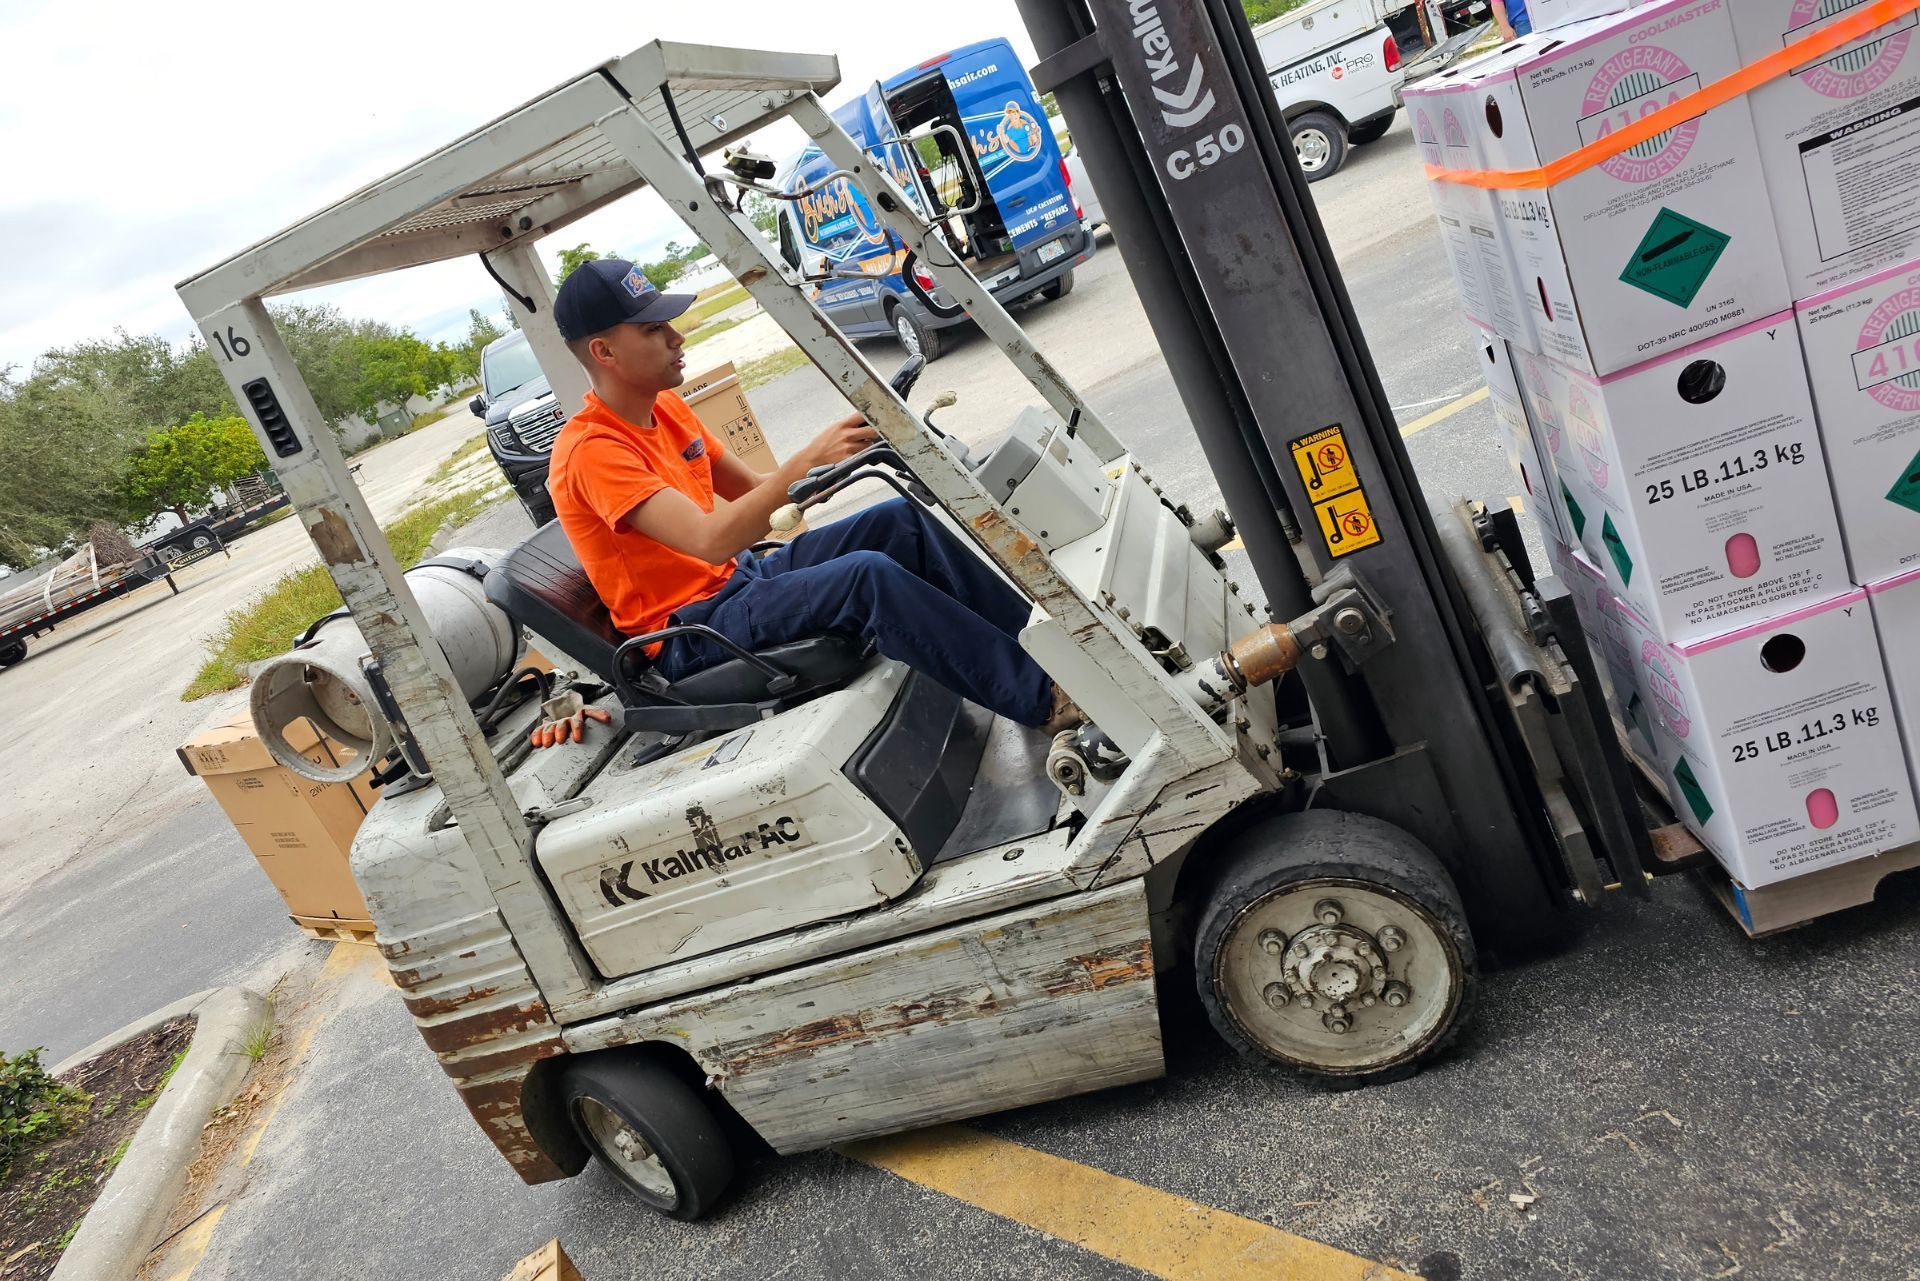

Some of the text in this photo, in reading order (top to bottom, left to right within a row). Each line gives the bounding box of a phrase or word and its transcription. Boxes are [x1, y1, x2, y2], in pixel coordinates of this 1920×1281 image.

[1628, 0, 1722, 45] COOLMASTER
[1280, 59, 1326, 87] HEATING,
[1326, 51, 1347, 68] INC.
[1346, 53, 1373, 71] PRO
[1530, 70, 1543, 81] Net
[1583, 58, 1595, 70] kg)
[1588, 48, 1682, 104] REFRIGERANT
[1808, 37, 1907, 97] REFRIGERANT
[1829, 107, 1902, 140] WARNING
[1602, 126, 1696, 181] REFRIGERANT
[1647, 185, 1662, 196] AND
[1650, 192, 1665, 204] AND
[1635, 242, 1716, 278] NON-FLAMMABLE GAS
[1706, 297, 1735, 313] UN 3163
[1808, 308, 1820, 317] Net
[1637, 335, 1667, 352] DOT-39
[1668, 328, 1687, 340] NRC
[1688, 317, 1719, 334] 400/500
[1766, 329, 1777, 341] Y
[1809, 317, 1818, 325] 25
[212, 326, 250, 362] 16
[1299, 426, 1340, 447] WARNING
[1645, 479, 1674, 504] 25
[1774, 442, 1805, 465] kg
[1704, 491, 1726, 502] MADE
[1736, 483, 1753, 493] USA
[167, 548, 209, 571] Kaufman
[1661, 570, 1716, 590] EMBALLAGE PERDU
[1692, 600, 1704, 609] DO
[1708, 594, 1723, 605] NOT
[1727, 586, 1753, 599] STORE
[1757, 576, 1785, 590] ABOVE
[1806, 568, 1811, 576] F
[1685, 610, 1697, 619] NE
[1698, 605, 1715, 615] PAS
[1716, 593, 1756, 611] STOCKER
[1757, 591, 1764, 599] A
[1765, 583, 1787, 596] PLUS
[1789, 579, 1801, 588] DE
[1816, 573, 1823, 581] C
[1690, 617, 1703, 625] NO
[1706, 597, 1769, 621] ALMACENARLO
[1768, 589, 1798, 603] SOBRE
[1843, 607, 1854, 618] Y
[1732, 741, 1759, 763] 25
[1851, 706, 1880, 727] kg
[1787, 750, 1808, 761] MADE
[1816, 743, 1832, 752] USA
[1769, 856, 1780, 865] NE
[1781, 852, 1798, 862] PAS
[1798, 841, 1836, 858] STOCKER
[1843, 832, 1865, 844] PLUS
[1865, 828, 1877, 837] DE
[1774, 862, 1786, 871] NO
[1788, 845, 1846, 867] ALMACENARLO
[1846, 837, 1874, 850] SOBRE
[1776, 848, 1788, 856] DO
[1790, 843, 1805, 852] NOT
[1809, 835, 1834, 847] STORE
[1836, 826, 1862, 839] ABOVE
